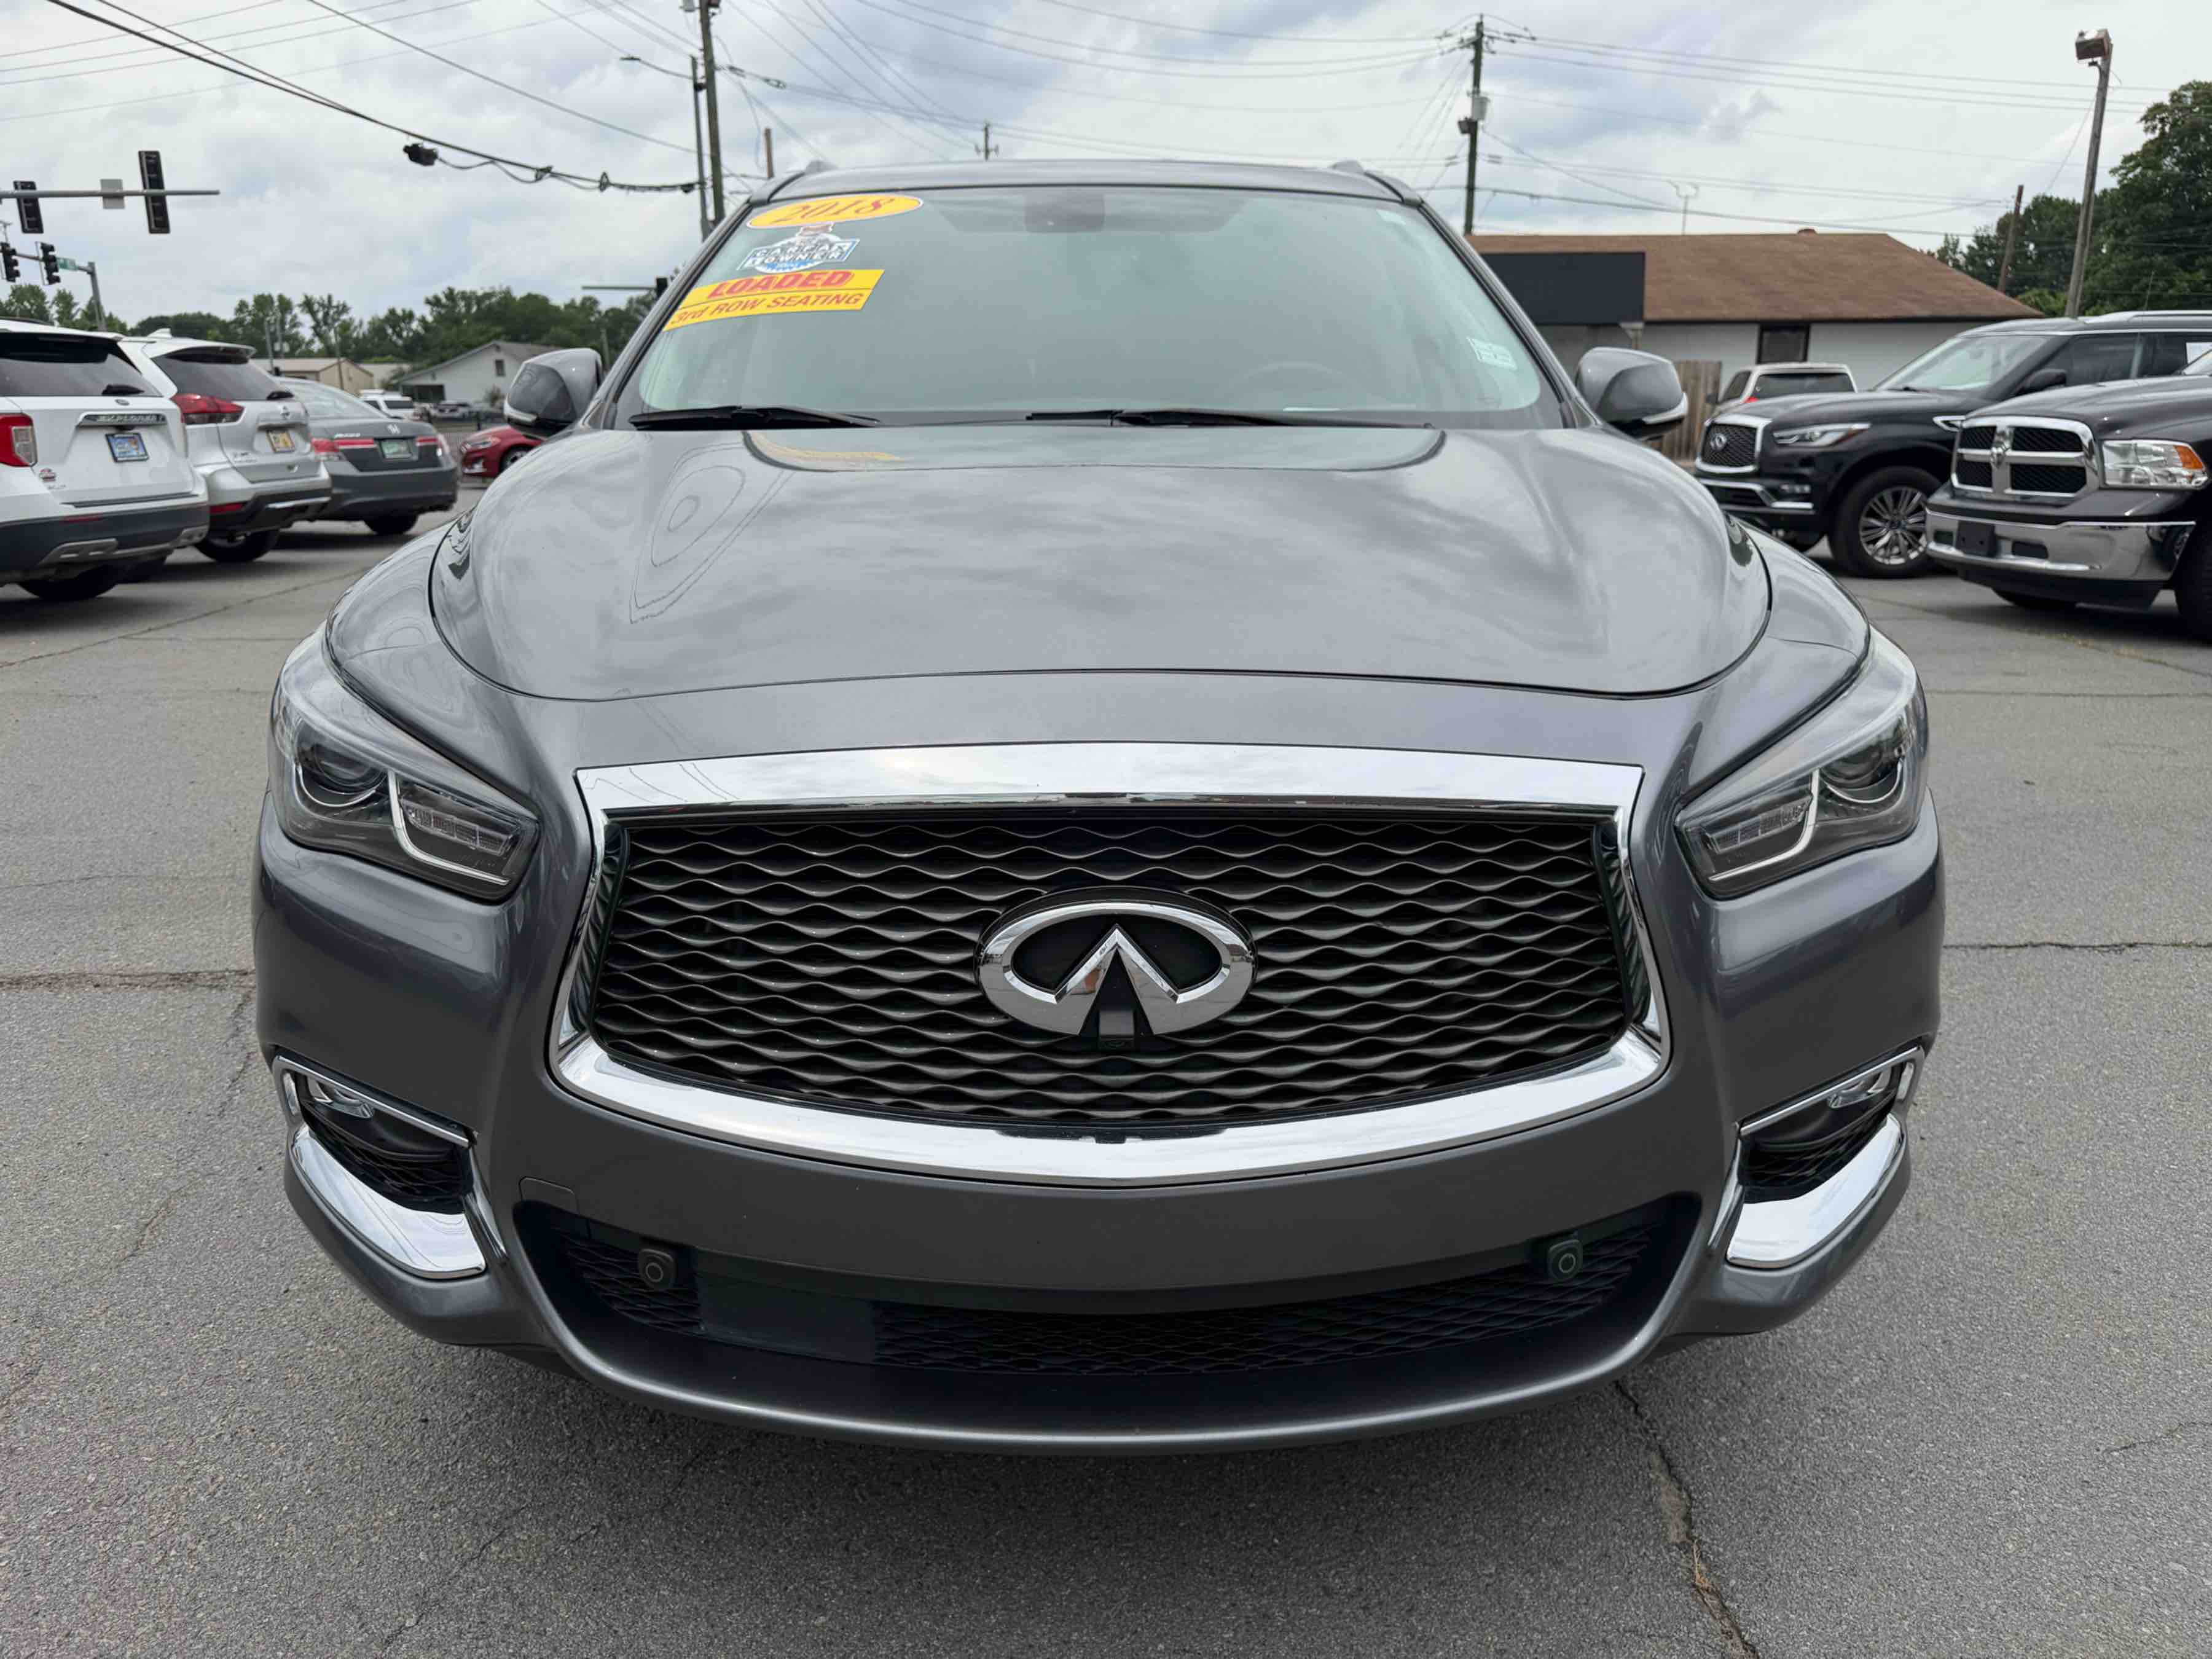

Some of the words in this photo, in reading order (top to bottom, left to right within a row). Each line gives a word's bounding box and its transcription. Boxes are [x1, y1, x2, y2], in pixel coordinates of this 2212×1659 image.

[770, 197, 896, 224] 2018
[707, 270, 854, 299] LOADED
[670, 307, 708, 324] 3rd
[710, 297, 767, 315] ROW
[766, 292, 863, 308] SEATING
